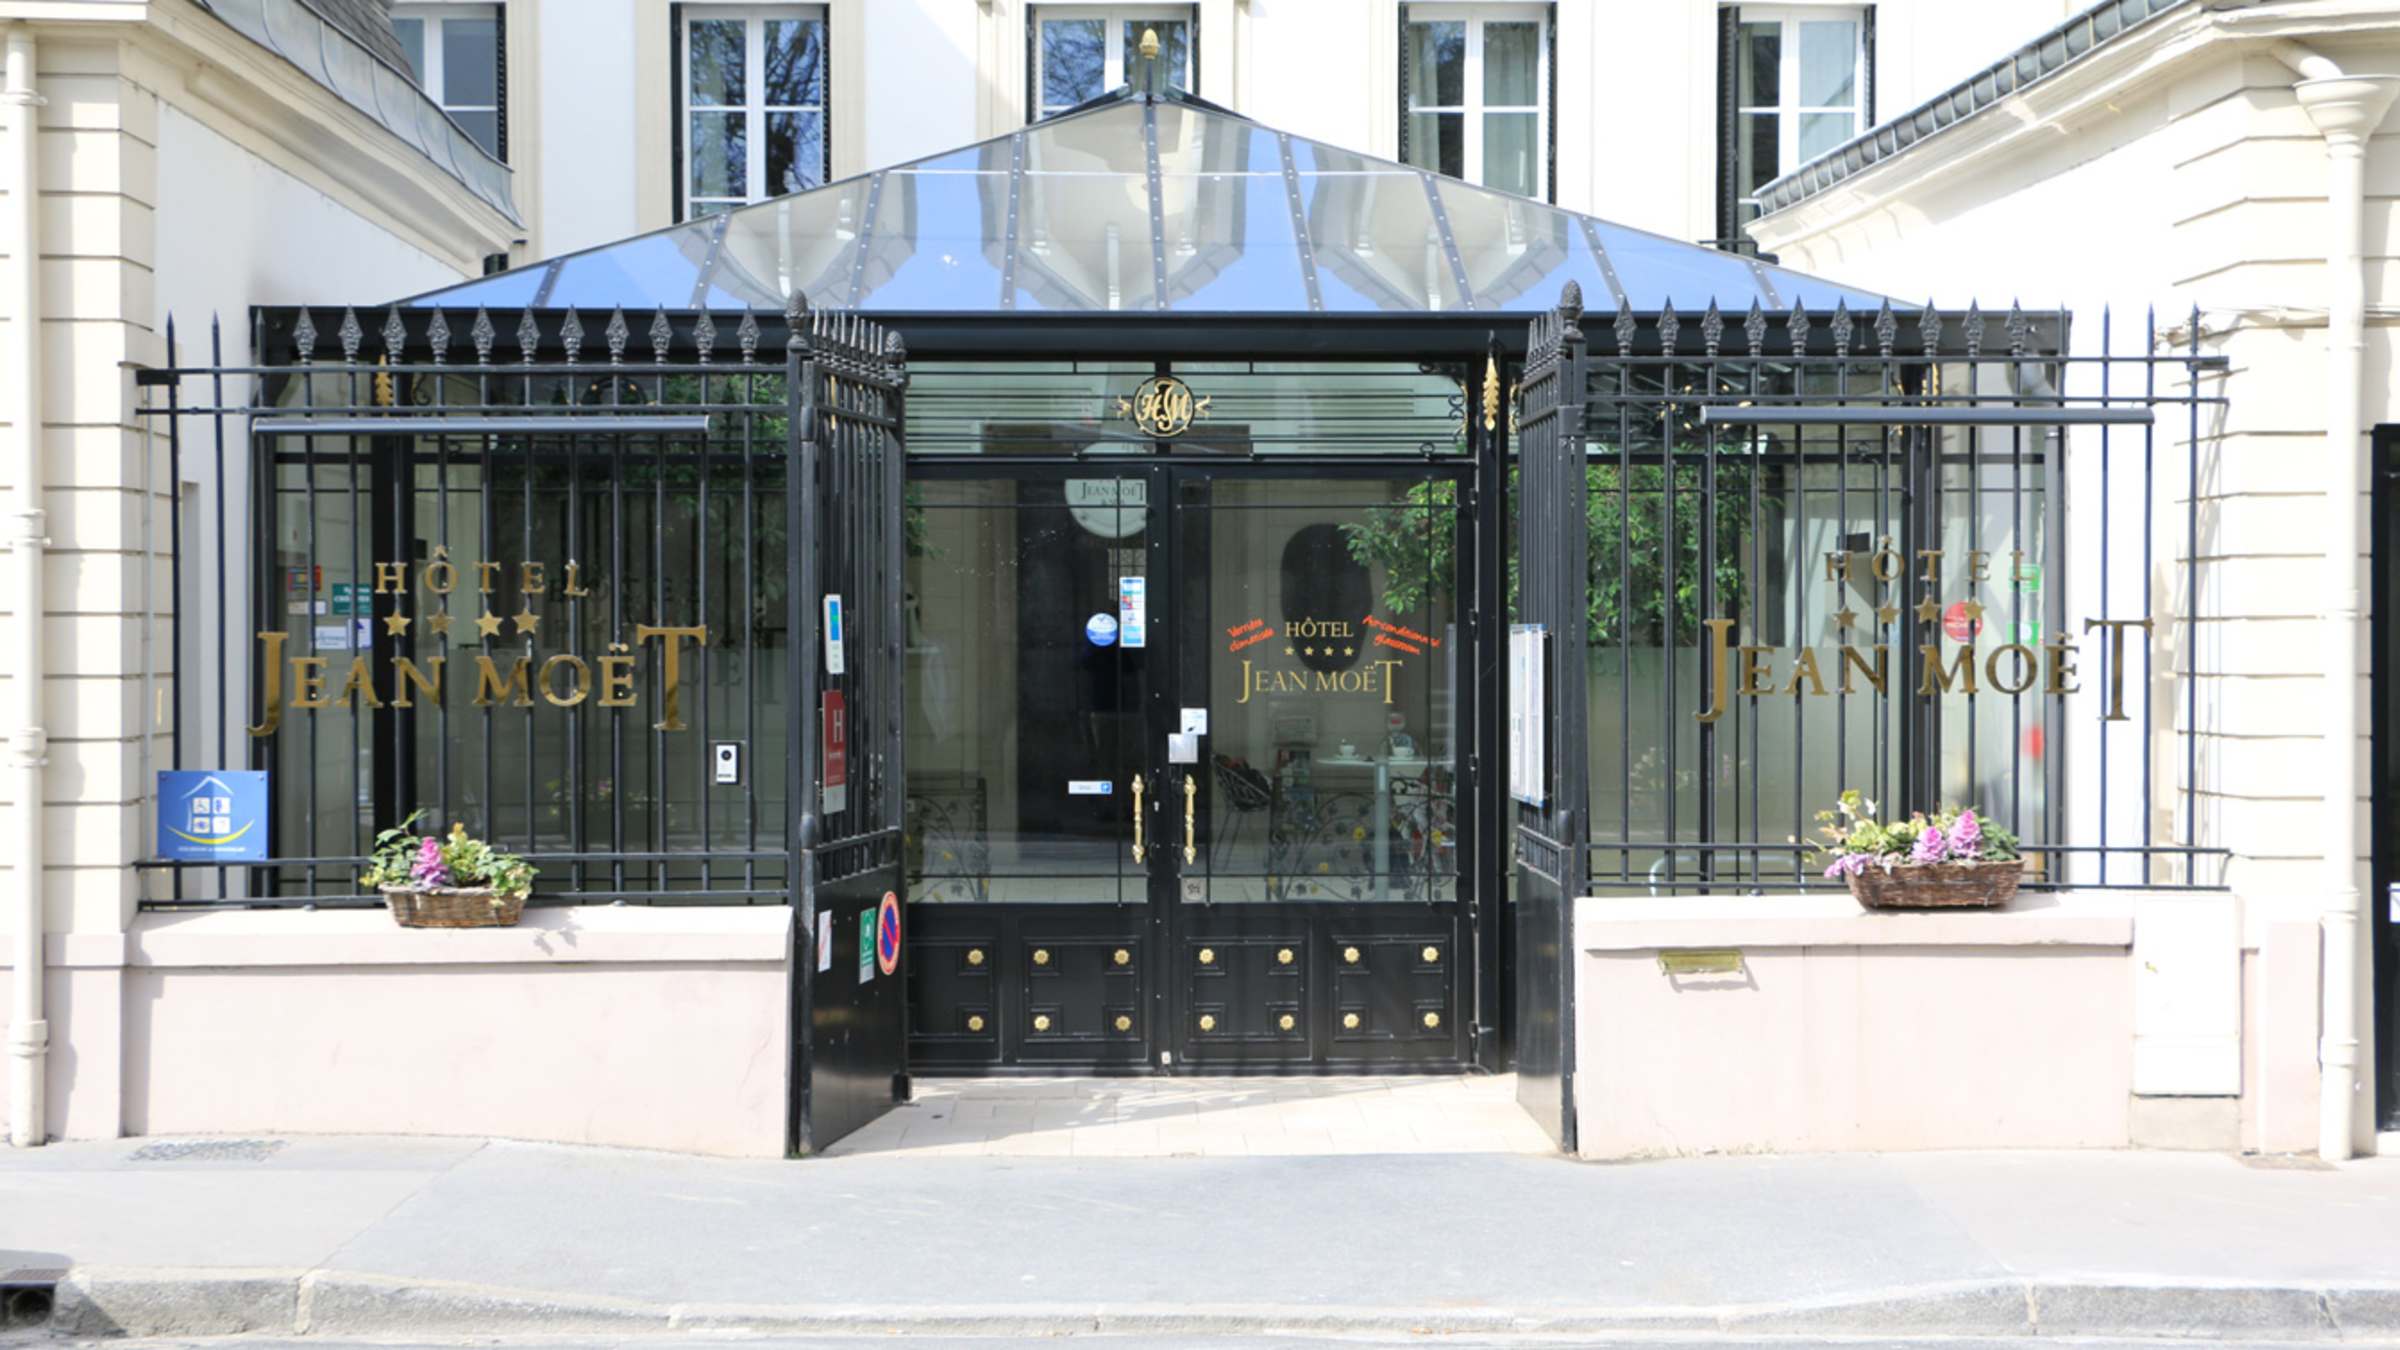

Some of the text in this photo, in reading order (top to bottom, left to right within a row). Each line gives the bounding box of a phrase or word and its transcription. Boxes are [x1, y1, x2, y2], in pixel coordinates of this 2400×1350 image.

[374, 544, 588, 597] HÔTEL
[1823, 535, 2036, 583] HÔTEL
[1285, 616, 1354, 638] HÔTEL
[246, 623, 707, 737] JEAN MOËT
[1237, 659, 1404, 704] JEAN MOËT
[1693, 616, 2155, 723] JEAN MOËT
[832, 709, 844, 743] H
